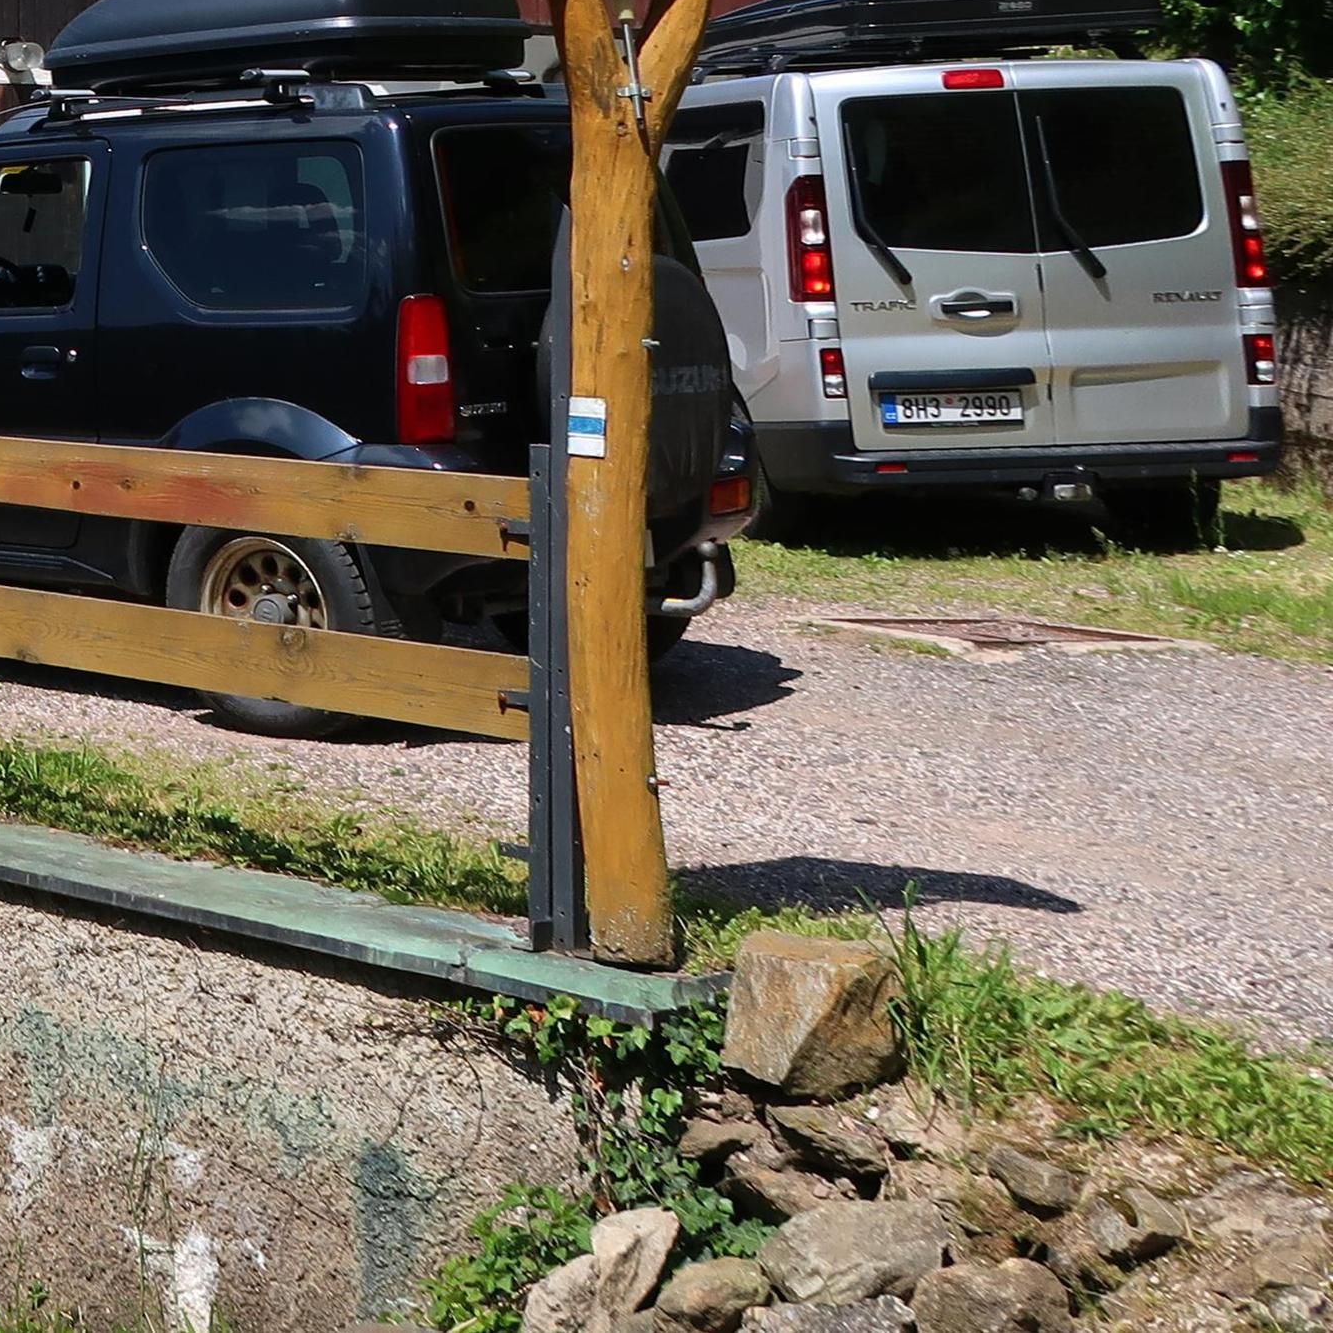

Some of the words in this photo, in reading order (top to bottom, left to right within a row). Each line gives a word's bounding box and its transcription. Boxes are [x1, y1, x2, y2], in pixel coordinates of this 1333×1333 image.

[850, 299, 917, 313] TRAFIC
[902, 397, 942, 419] 8H3
[958, 395, 1011, 417] 2990
